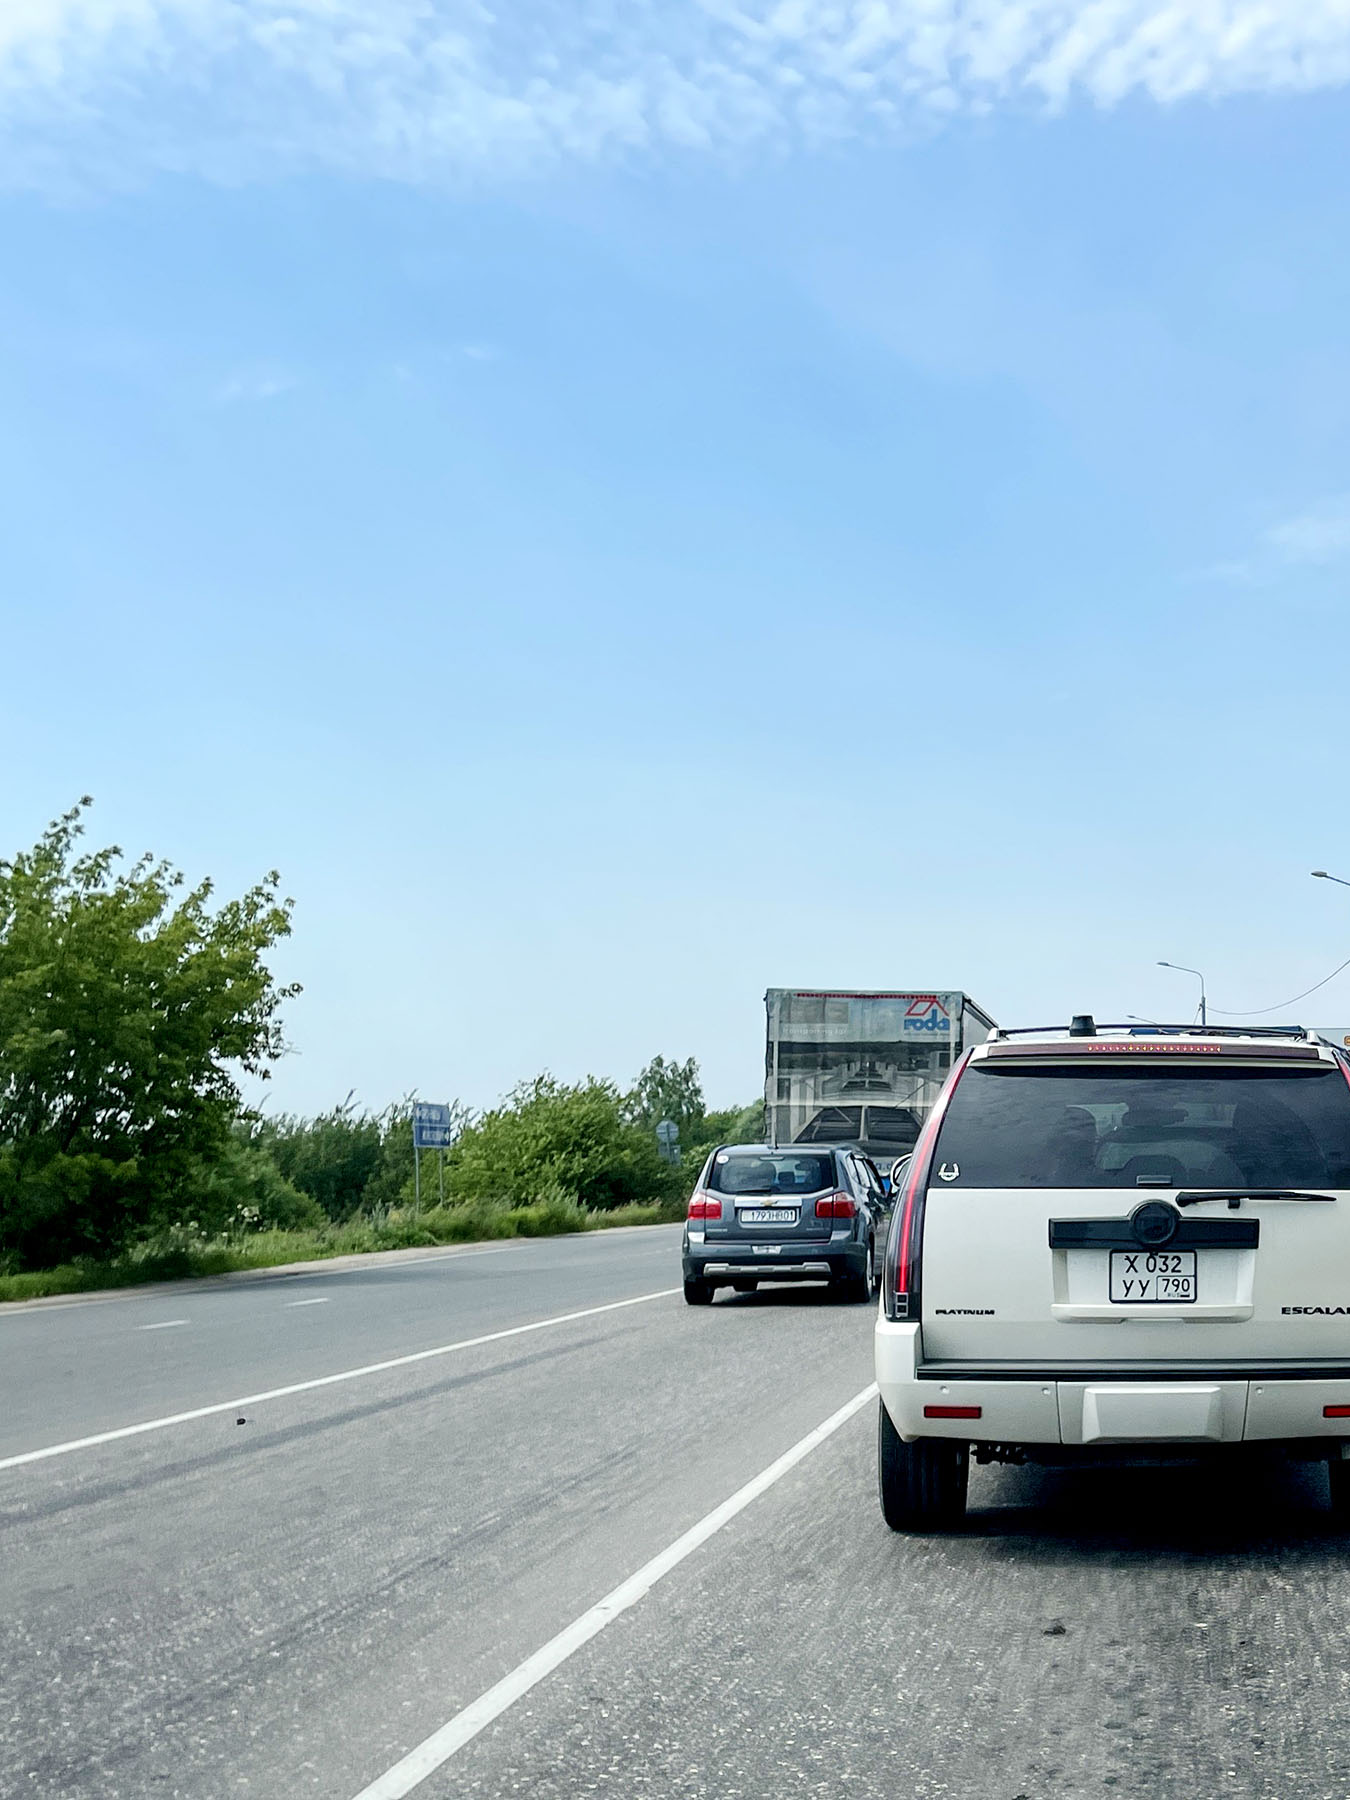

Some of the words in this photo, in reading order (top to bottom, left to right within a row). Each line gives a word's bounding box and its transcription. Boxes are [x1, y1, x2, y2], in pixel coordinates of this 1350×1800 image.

[904, 1009, 949, 1030] roda
[1146, 1255, 1182, 1273] 032
[1162, 1278, 1190, 1292] 790
